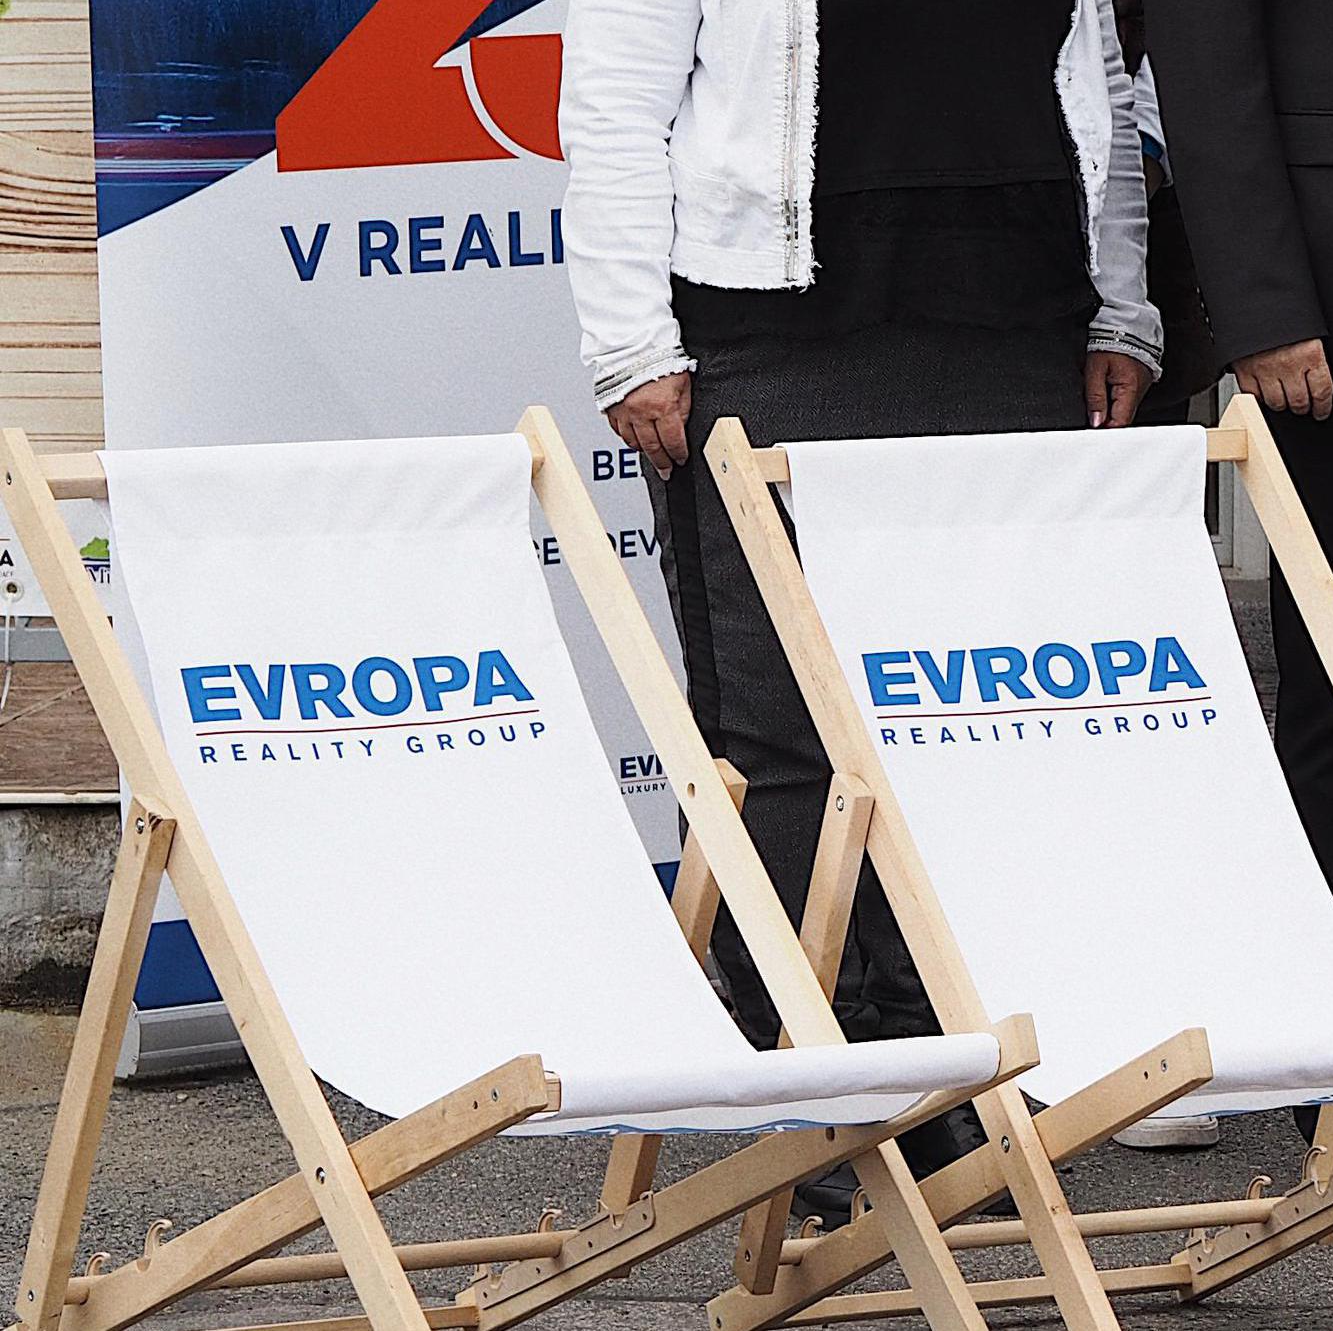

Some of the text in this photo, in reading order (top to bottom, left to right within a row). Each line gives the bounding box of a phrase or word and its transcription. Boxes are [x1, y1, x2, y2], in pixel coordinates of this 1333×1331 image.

[282, 207, 562, 282] V REALI
[592, 448, 645, 481] BE
[181, 649, 534, 723] EVROPA
[862, 636, 1207, 707] EVROPA
[200, 721, 548, 764] REALITY GROUP
[881, 707, 1219, 746] REALITY GROUP
[620, 782, 666, 795] LUXURY
